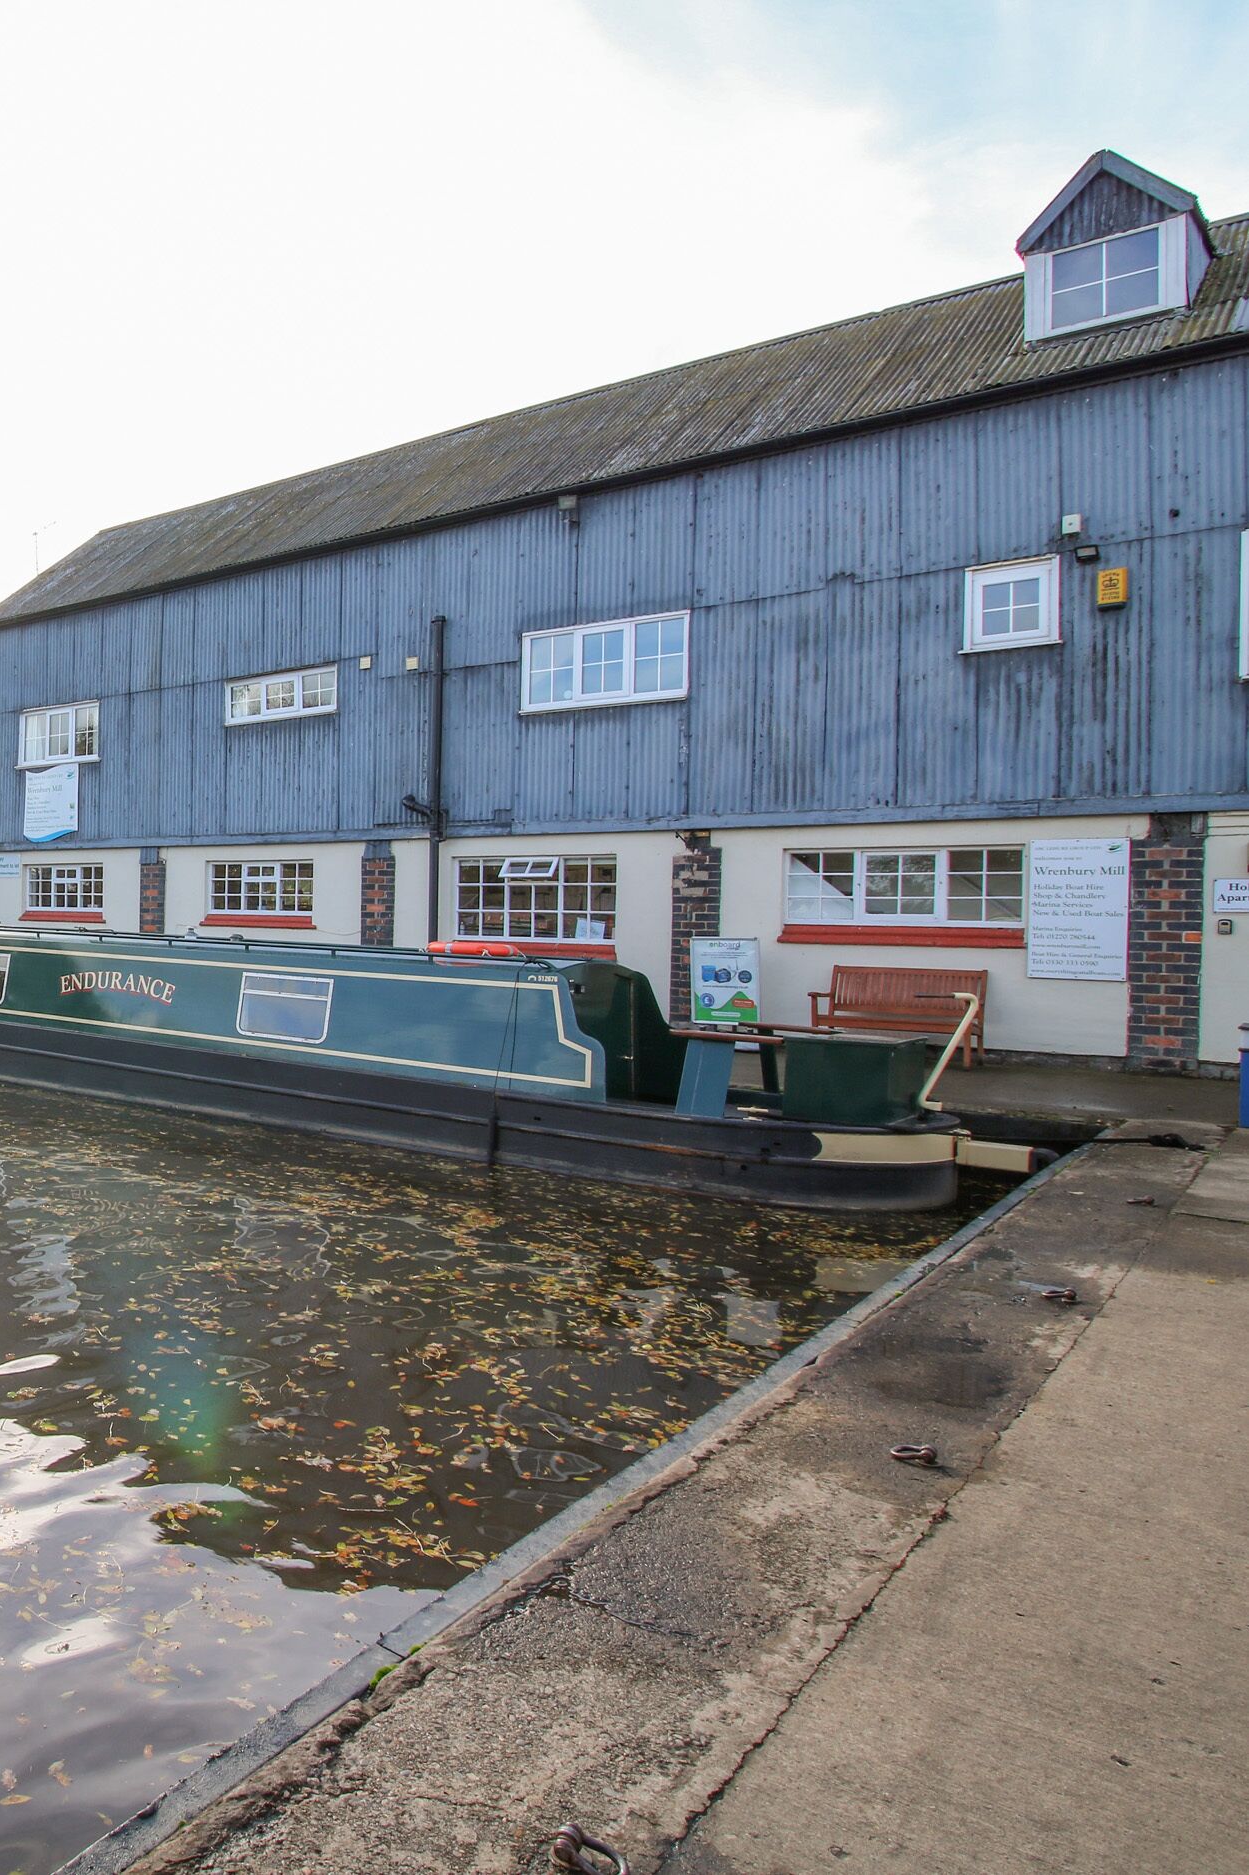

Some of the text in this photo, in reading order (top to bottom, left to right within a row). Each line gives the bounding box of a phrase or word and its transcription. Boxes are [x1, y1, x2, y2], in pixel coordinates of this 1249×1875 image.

[1034, 865, 1125, 877] Wrenbury Mill
[1033, 883, 1063, 891] Holiday
[1229, 883, 1249, 891] Ho
[1033, 892, 1052, 900] Shop
[1064, 892, 1106, 900] Chandlery
[1217, 894, 1249, 904] Apar
[709, 941, 741, 949] onboard
[59, 971, 176, 1005] ENDURANCE
